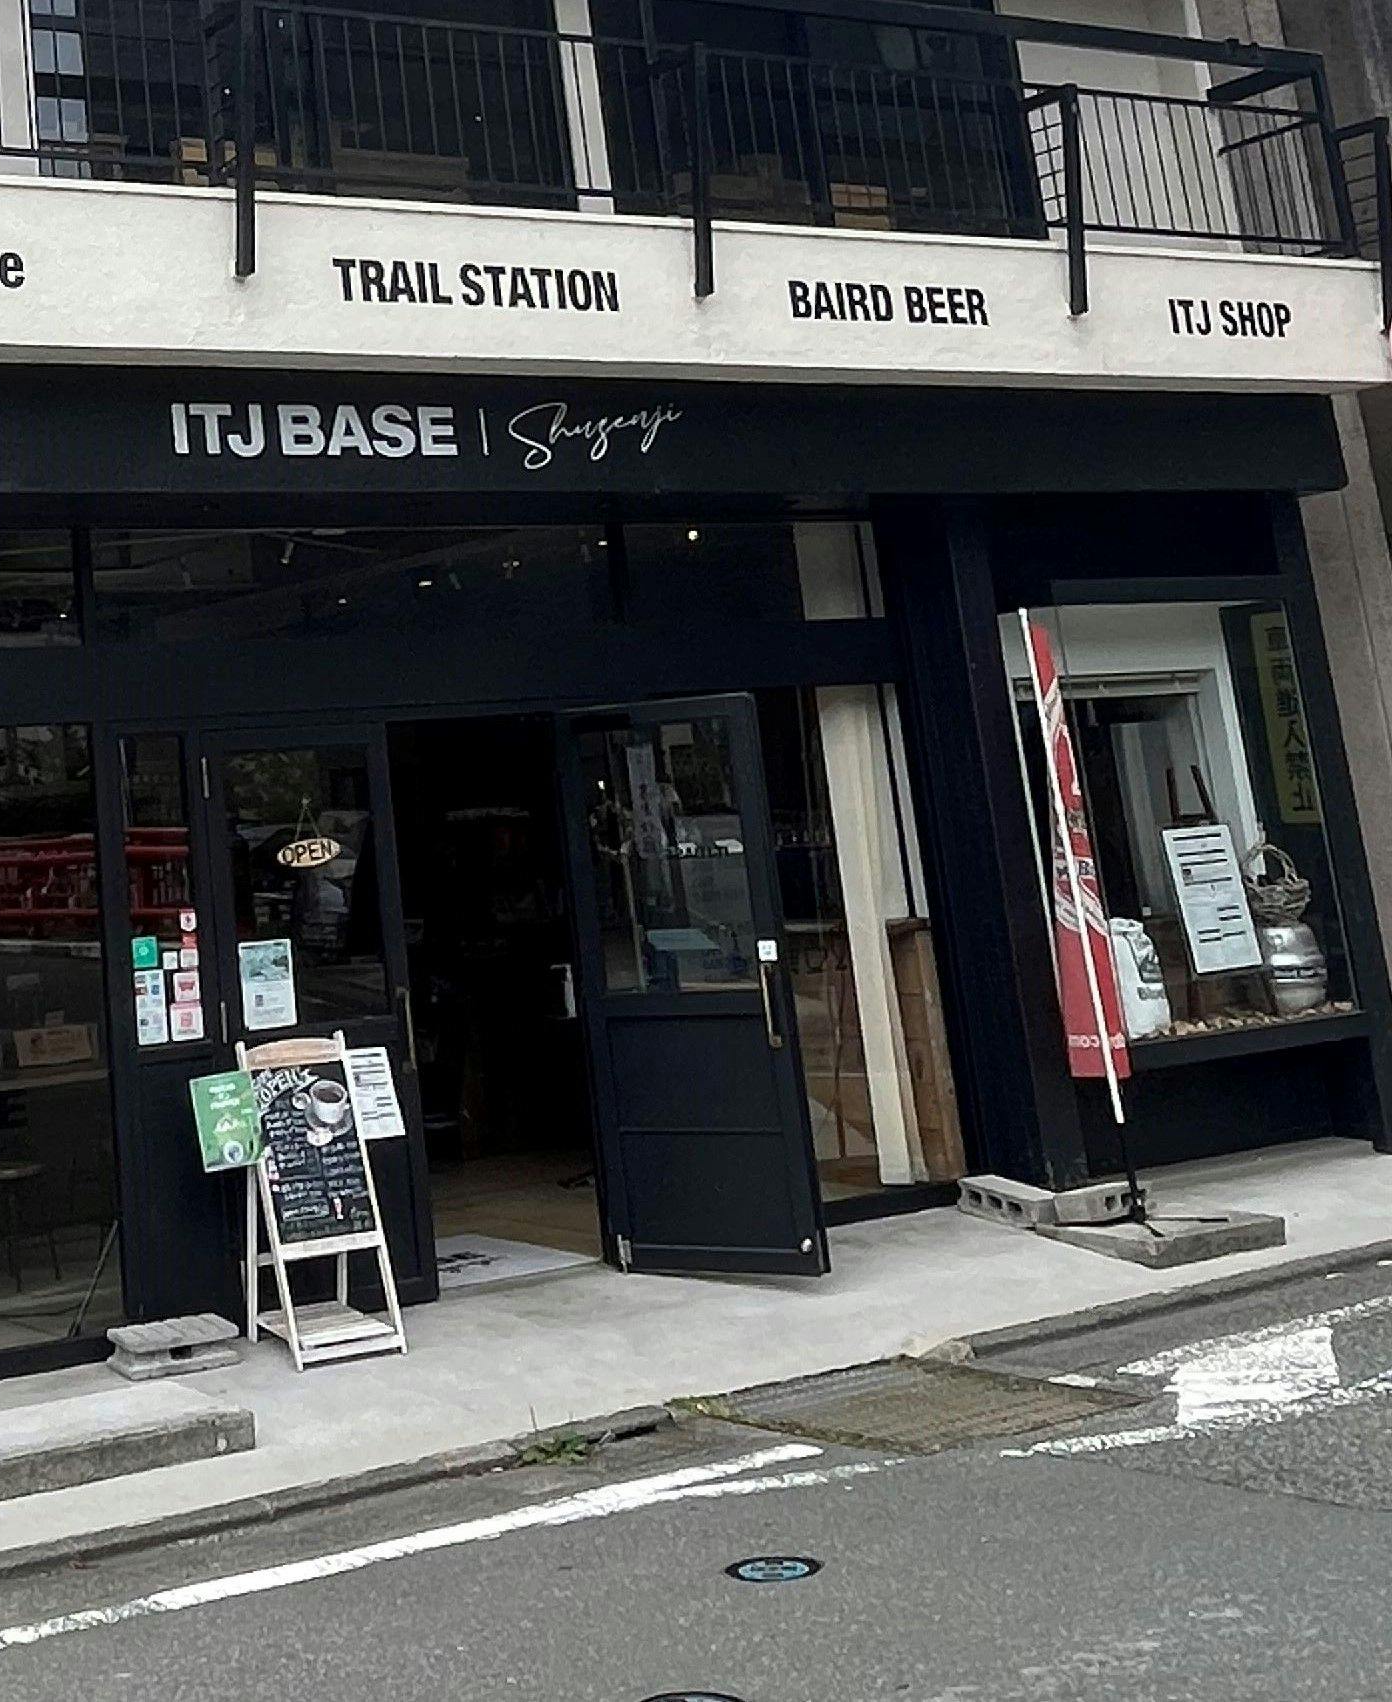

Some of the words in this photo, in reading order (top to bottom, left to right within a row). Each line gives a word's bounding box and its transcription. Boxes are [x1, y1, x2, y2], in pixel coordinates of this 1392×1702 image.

[332, 257, 454, 306] TRAIL
[458, 262, 620, 312] STATION
[787, 280, 894, 322] BAIRD
[903, 285, 989, 326] BEER
[1168, 298, 1212, 336] ITJ
[1218, 300, 1292, 338] SHOP
[170, 403, 266, 458] ITJ
[276, 404, 459, 458] BASE
[508, 402, 683, 470] Shuzenji
[282, 841, 332, 864] OPEN
